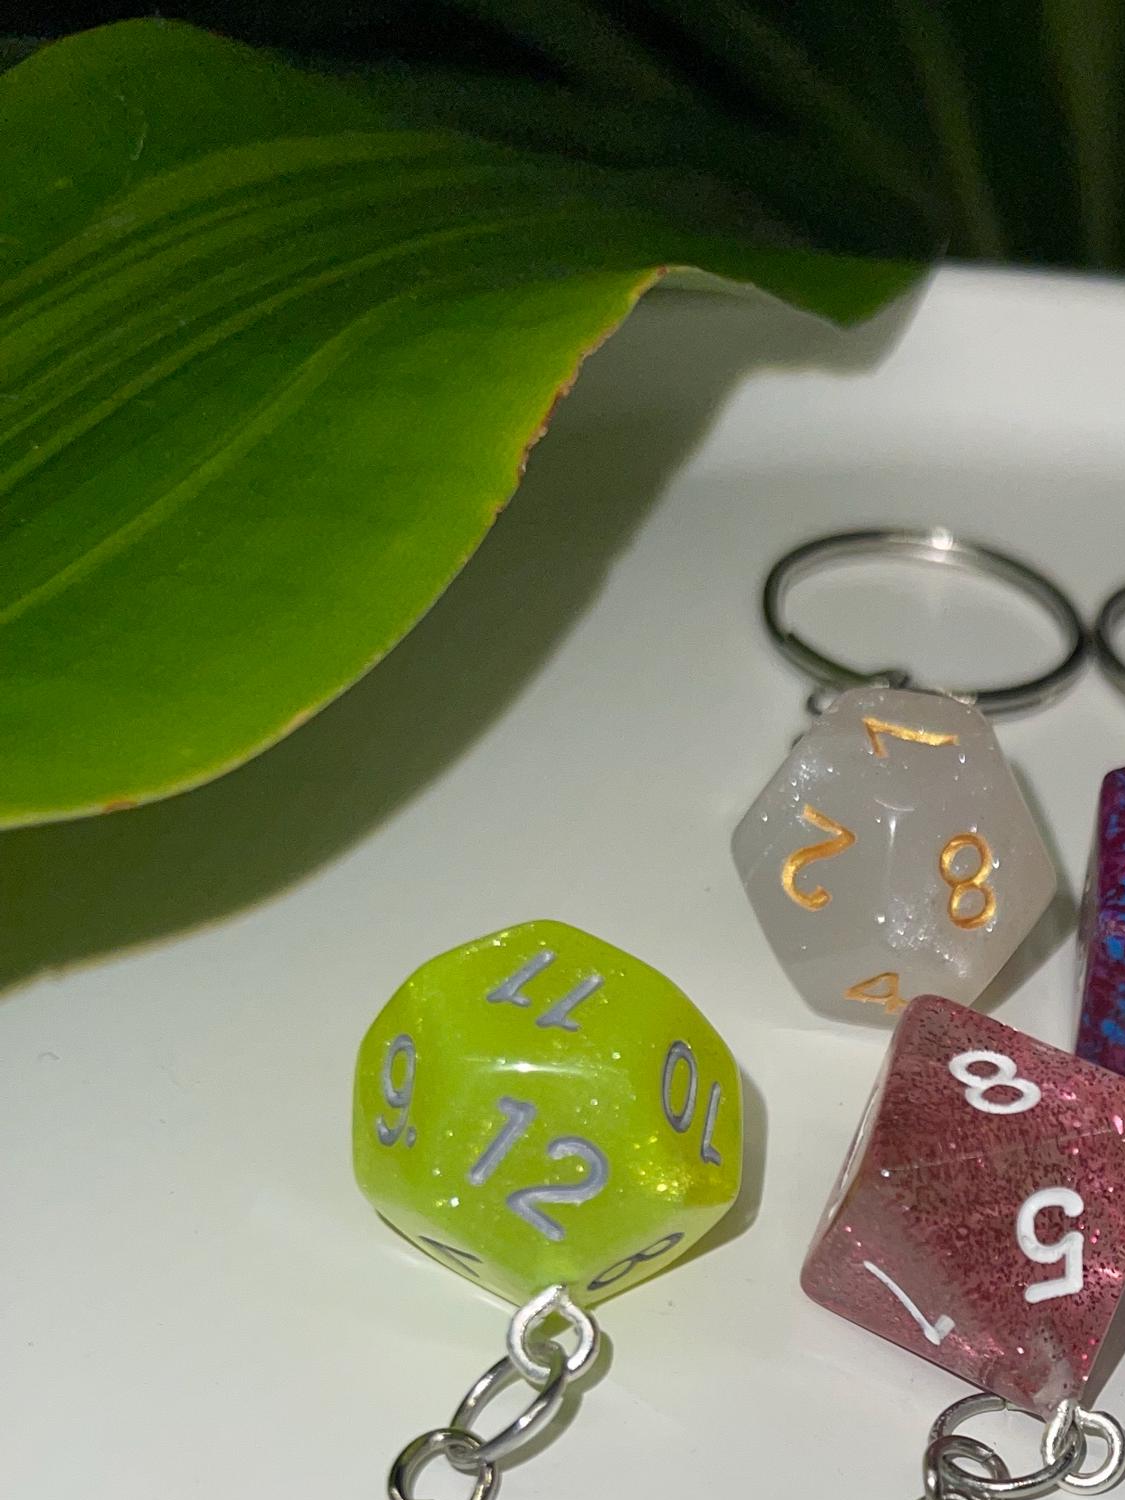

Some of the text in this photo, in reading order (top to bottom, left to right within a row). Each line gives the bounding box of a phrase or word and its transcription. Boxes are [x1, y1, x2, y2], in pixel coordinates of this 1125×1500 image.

[781, 804, 856, 912] 2
[940, 832, 997, 931] 8
[486, 949, 603, 1033] 11
[844, 971, 910, 1015] 4
[661, 1039, 722, 1167] 10
[948, 1050, 1042, 1115] 8
[468, 1096, 609, 1242] 12
[586, 1231, 685, 1291] 8
[1016, 1186, 1085, 1304] 5
